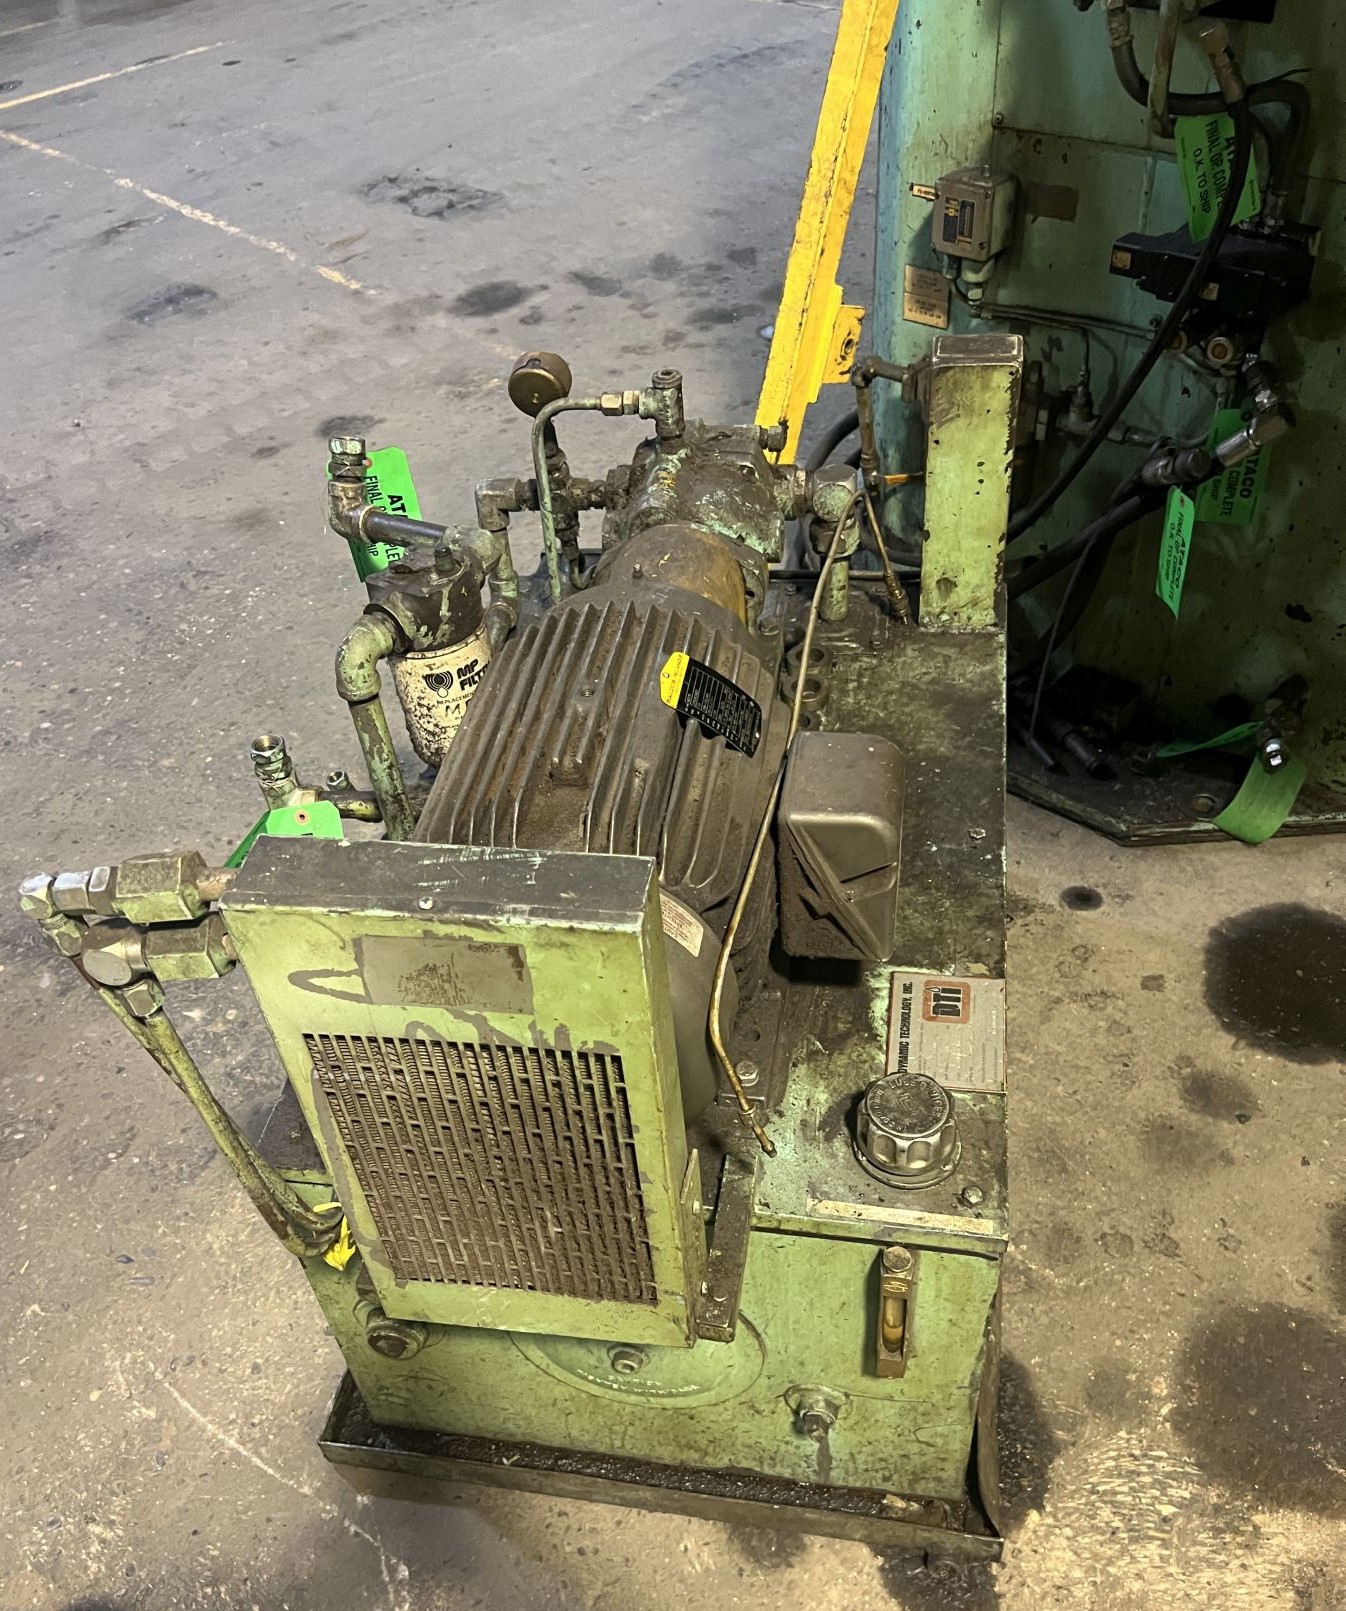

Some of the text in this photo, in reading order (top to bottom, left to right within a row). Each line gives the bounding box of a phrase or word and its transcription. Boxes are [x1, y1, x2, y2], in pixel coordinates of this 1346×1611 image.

[1205, 120, 1220, 152] FINAL
[1197, 172, 1208, 188] TO
[1199, 190, 1211, 214] SHIP
[364, 476, 383, 506] FINAL
[1173, 512, 1184, 538] FINAL
[1175, 536, 1187, 588] ATACO
[456, 659, 479, 679] MP
[902, 982, 913, 994] INC.
[898, 1041, 911, 1073] DYNAMIC
